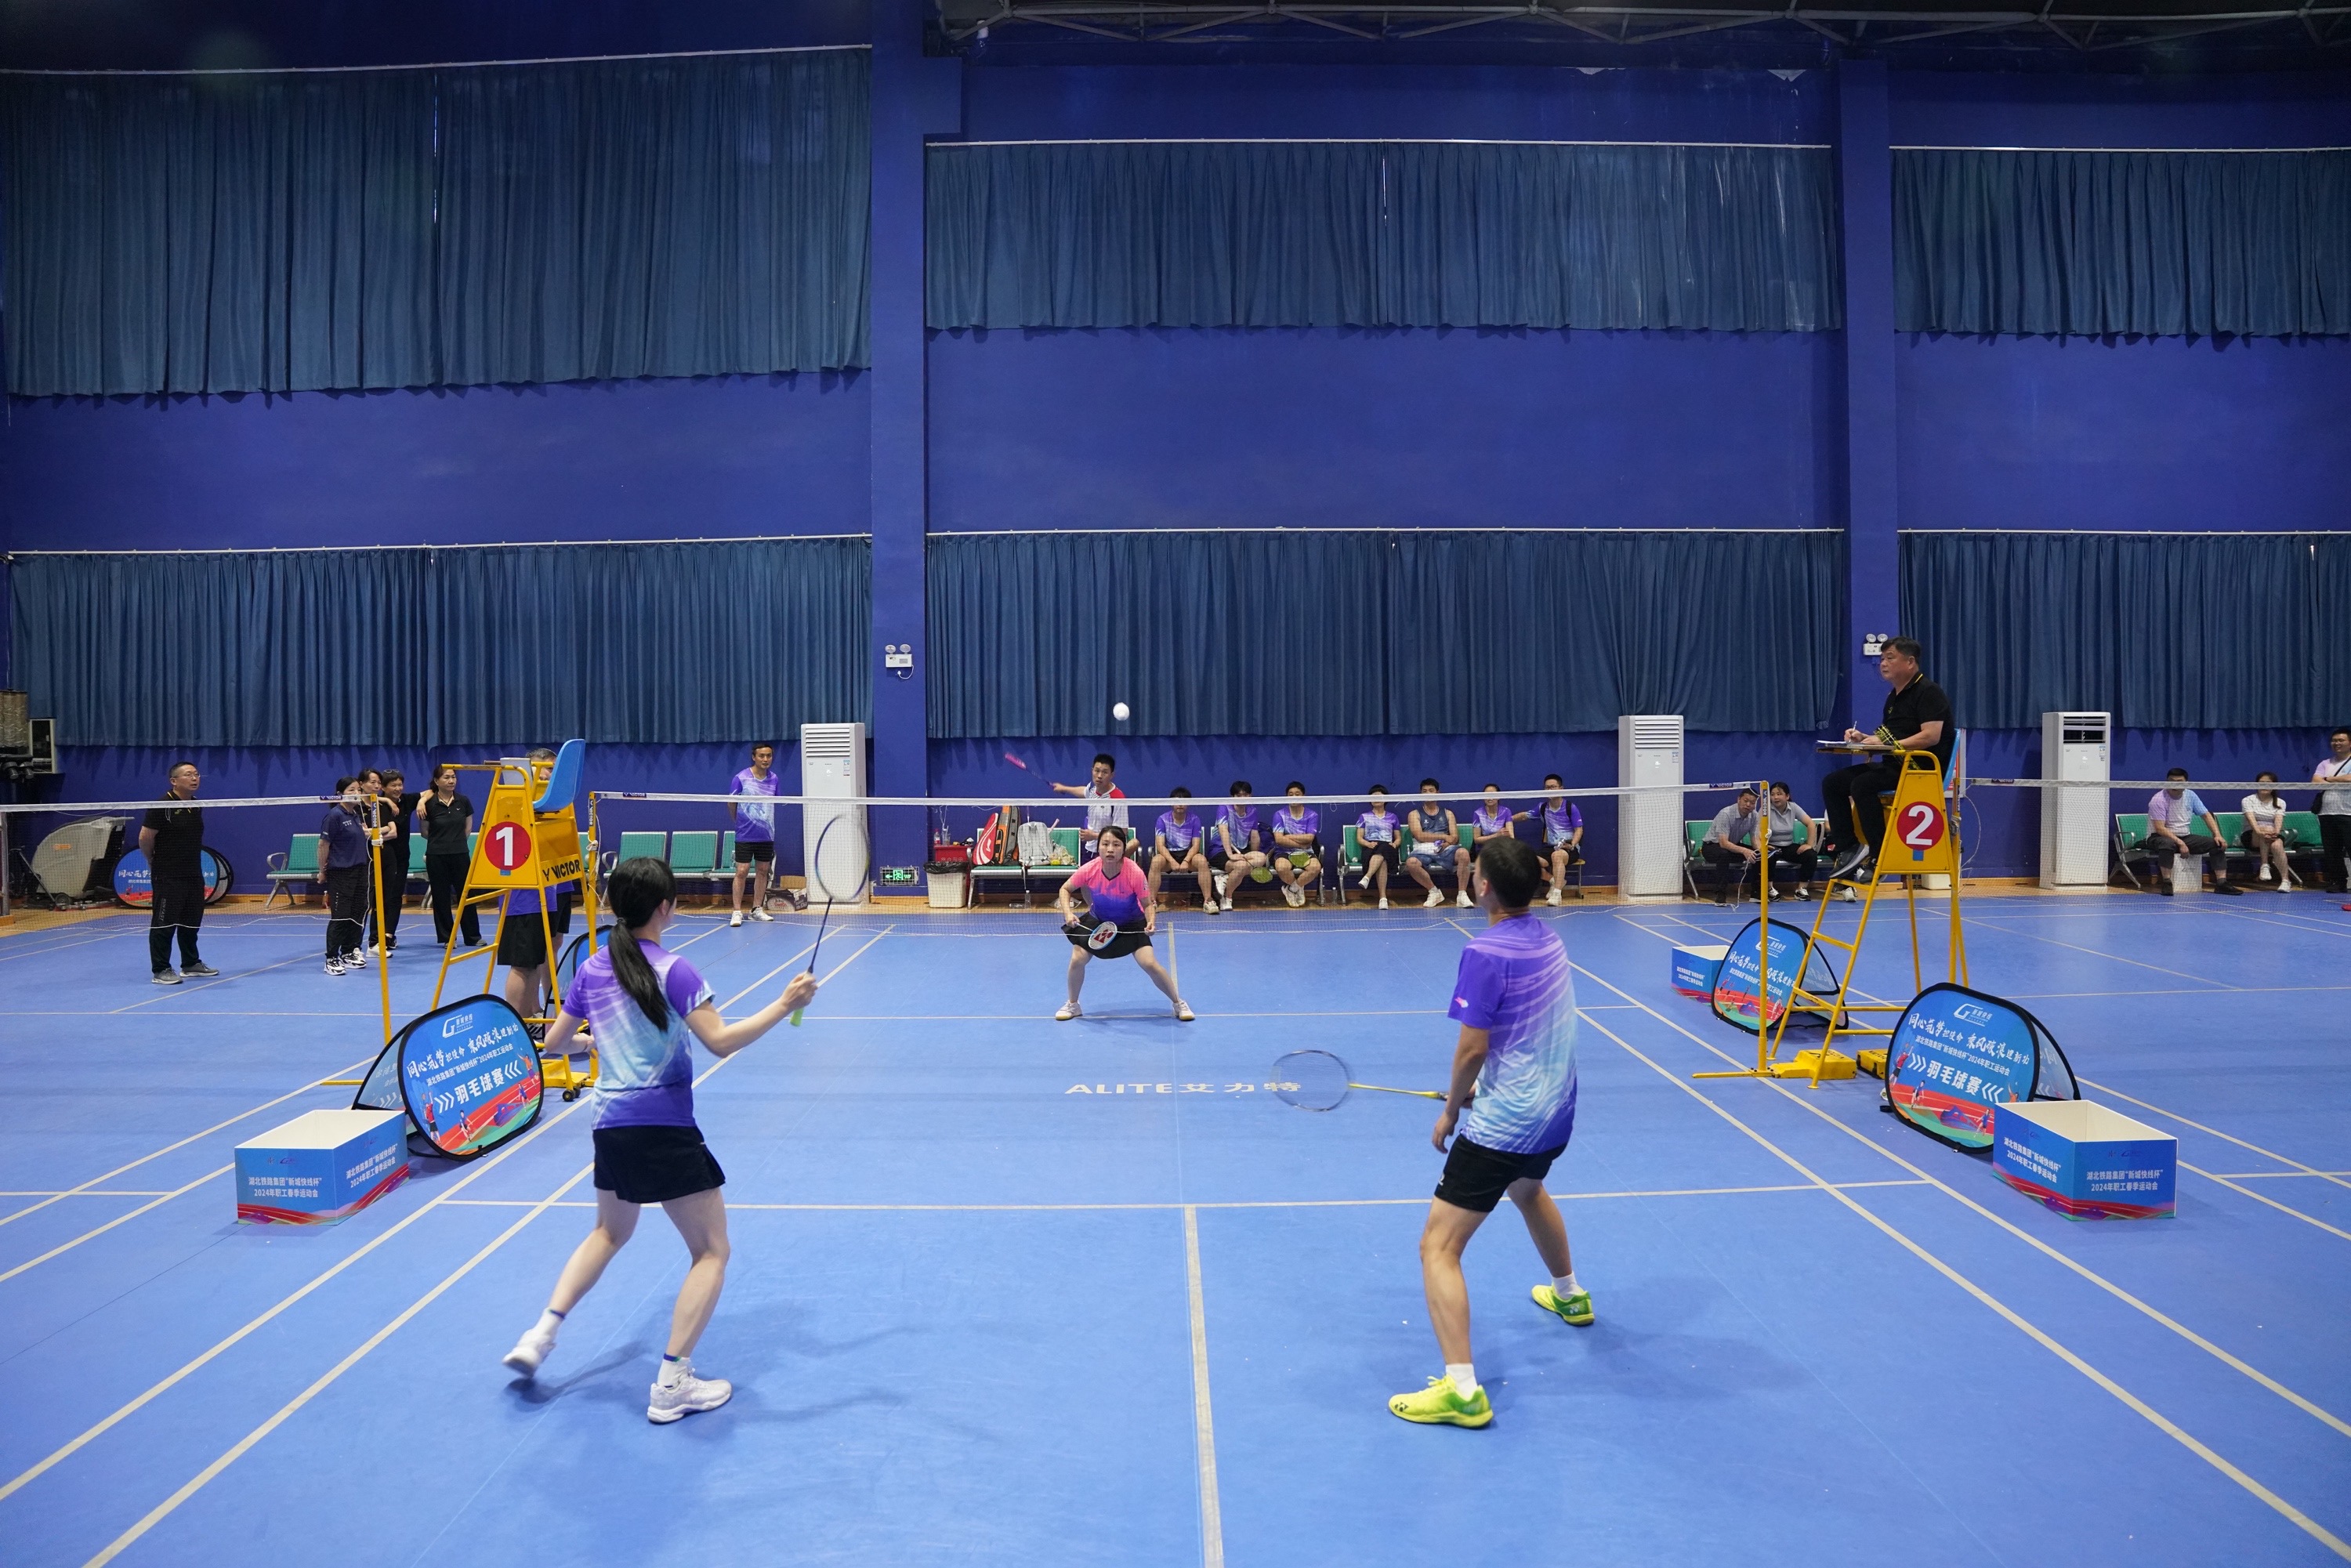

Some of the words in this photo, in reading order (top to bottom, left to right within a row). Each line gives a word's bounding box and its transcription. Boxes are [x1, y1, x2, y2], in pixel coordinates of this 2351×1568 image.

[1906, 805, 1934, 846] 2
[496, 827, 513, 867] 1
[551, 859, 581, 879] VICTOR
[1908, 1012, 1964, 1044] 同心筑梦担使命
[1965, 1030, 2030, 1065] 乘风破浪建新功
[406, 1045, 465, 1078] 同心筑梦担使命
[1926, 1059, 1983, 1096] 羽毛球赛
[454, 1067, 505, 1105] 羽毛球赛
